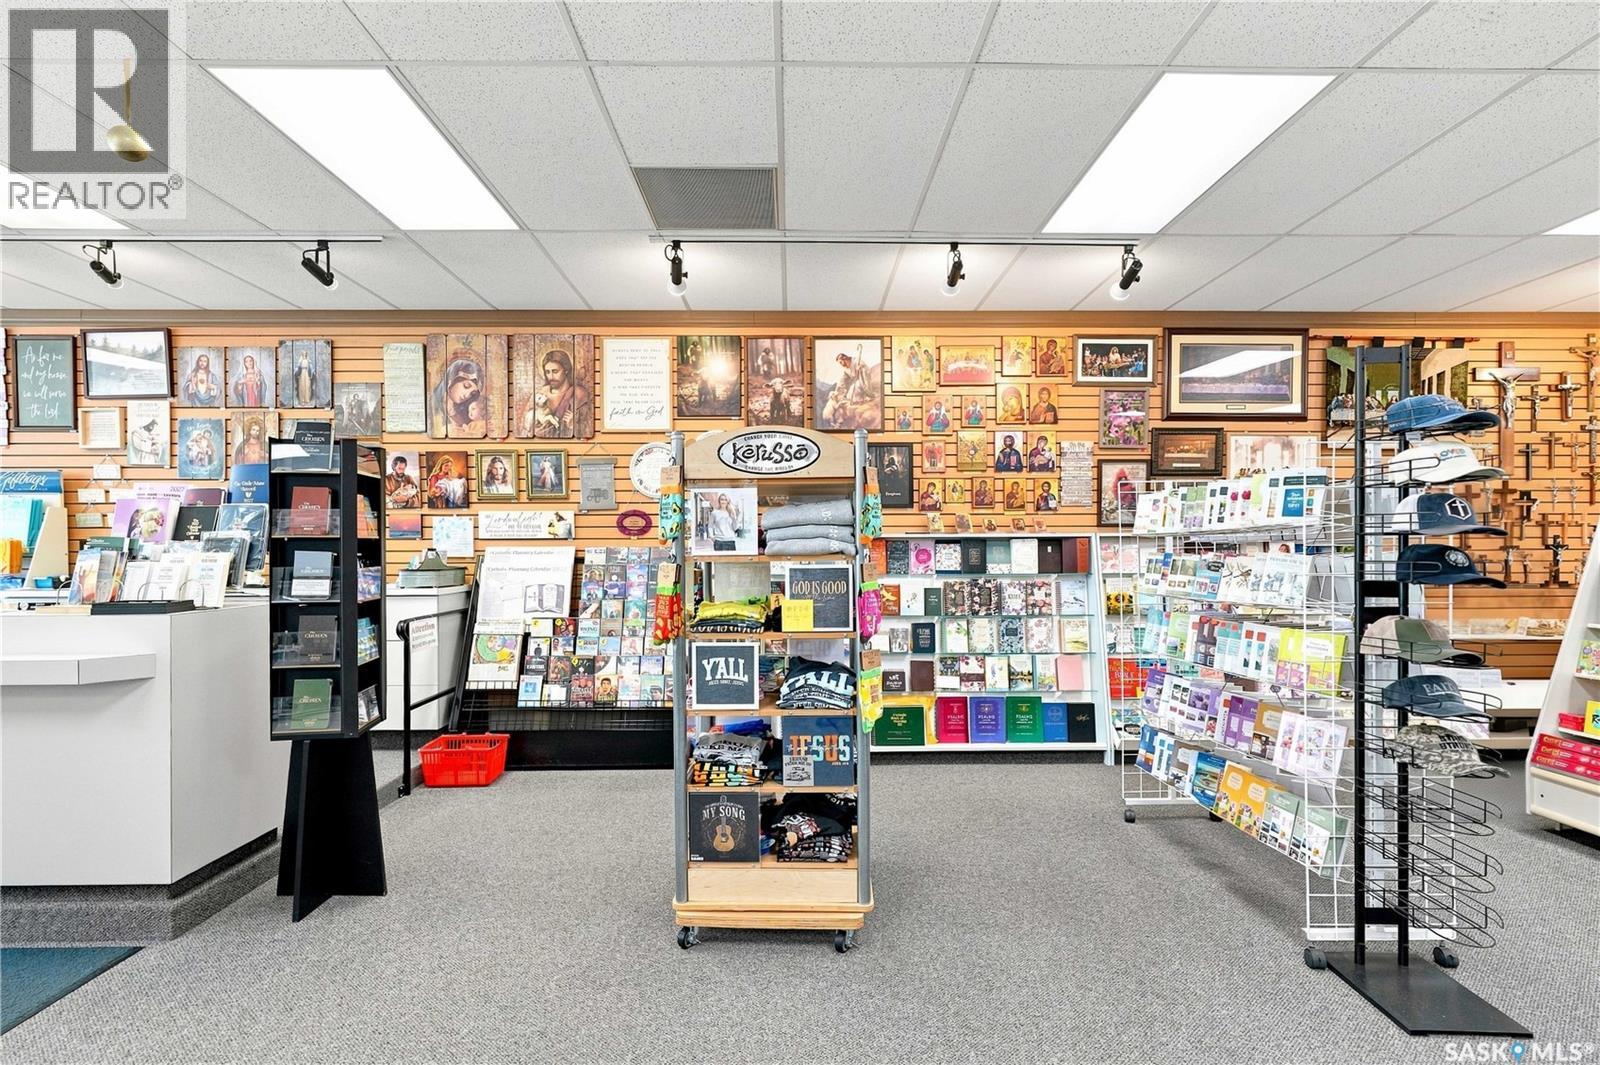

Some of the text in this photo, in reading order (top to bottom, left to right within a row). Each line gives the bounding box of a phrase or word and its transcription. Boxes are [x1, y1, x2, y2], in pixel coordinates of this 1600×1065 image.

[792, 580, 847, 595] GOD IS GOOD
[701, 656, 749, 683] Y'ALL
[790, 735, 850, 762] JESUS
[702, 806, 717, 821] MY
[719, 805, 746, 821] SONG
